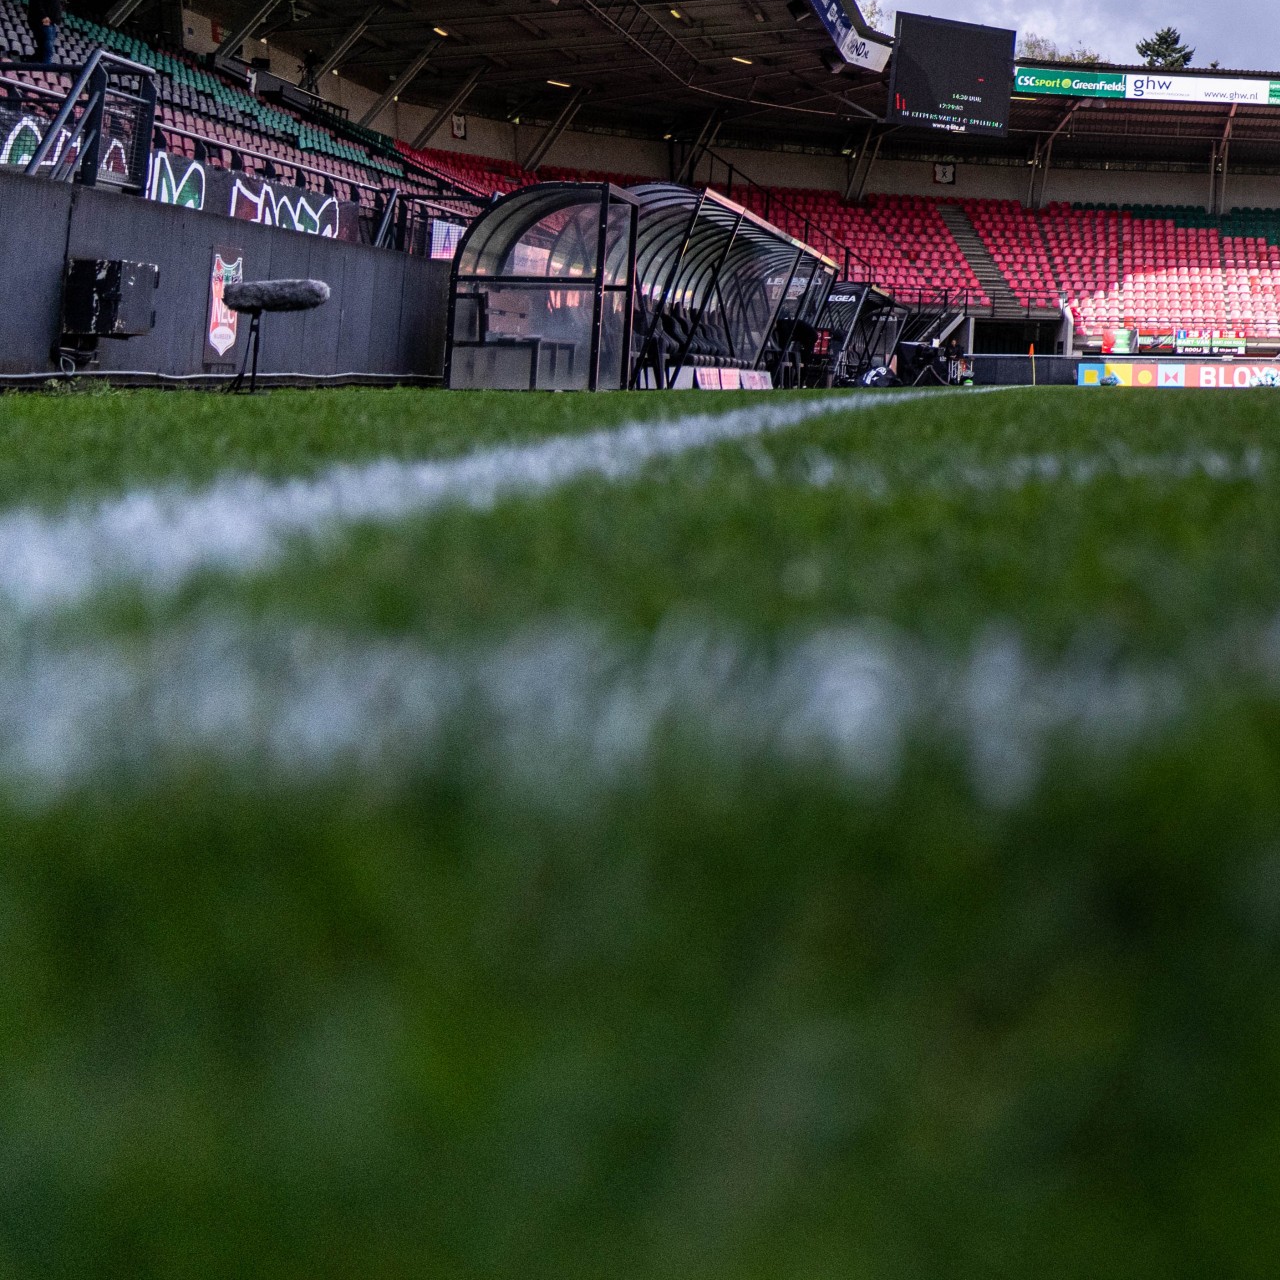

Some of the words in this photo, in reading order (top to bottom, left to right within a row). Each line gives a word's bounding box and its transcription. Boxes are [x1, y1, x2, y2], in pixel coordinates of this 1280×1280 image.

[1133, 76, 1172, 96] ghw
[1204, 90, 1258, 100] www.ghw.nl
[828, 294, 856, 302] EGEA
